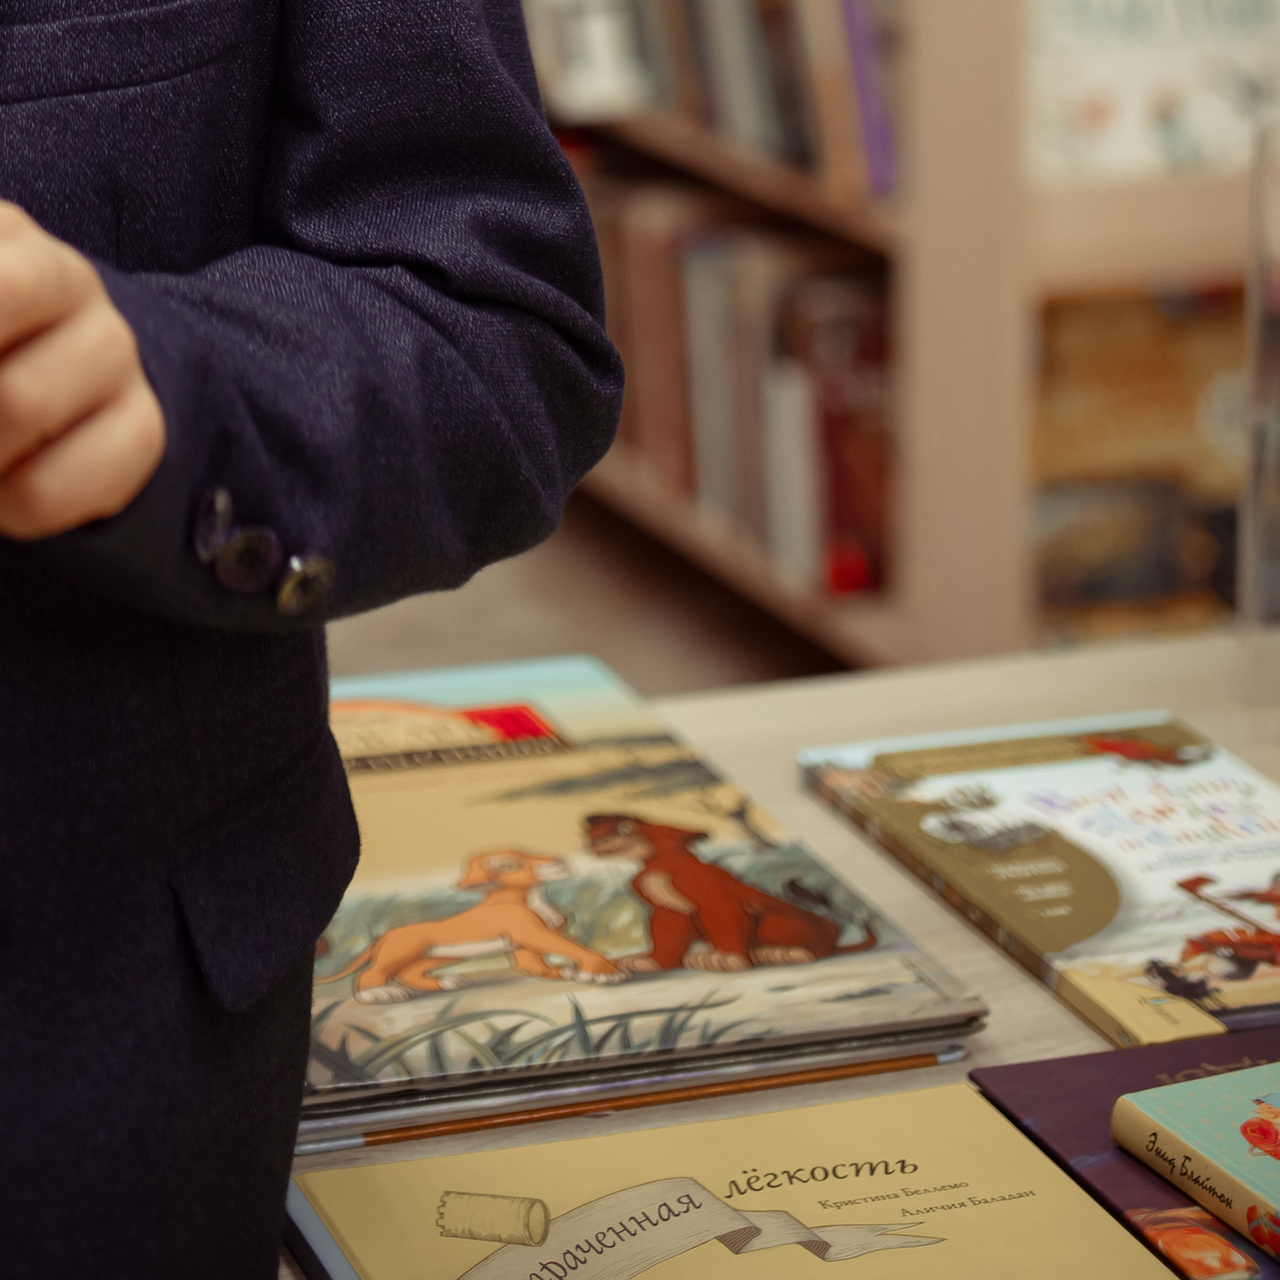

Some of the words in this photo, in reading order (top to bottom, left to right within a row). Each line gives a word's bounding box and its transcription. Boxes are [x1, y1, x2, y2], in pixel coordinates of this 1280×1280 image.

[818, 1191, 901, 1210] Кристина
[900, 1180, 969, 1197] Беллемо
[900, 1201, 968, 1217] Аличия
[967, 1190, 1036, 1206] Баладан
[1180, 1155, 1233, 1210] Блайтон
[529, 1193, 703, 1280] раченная
[724, 1159, 918, 1198] лёгкость
